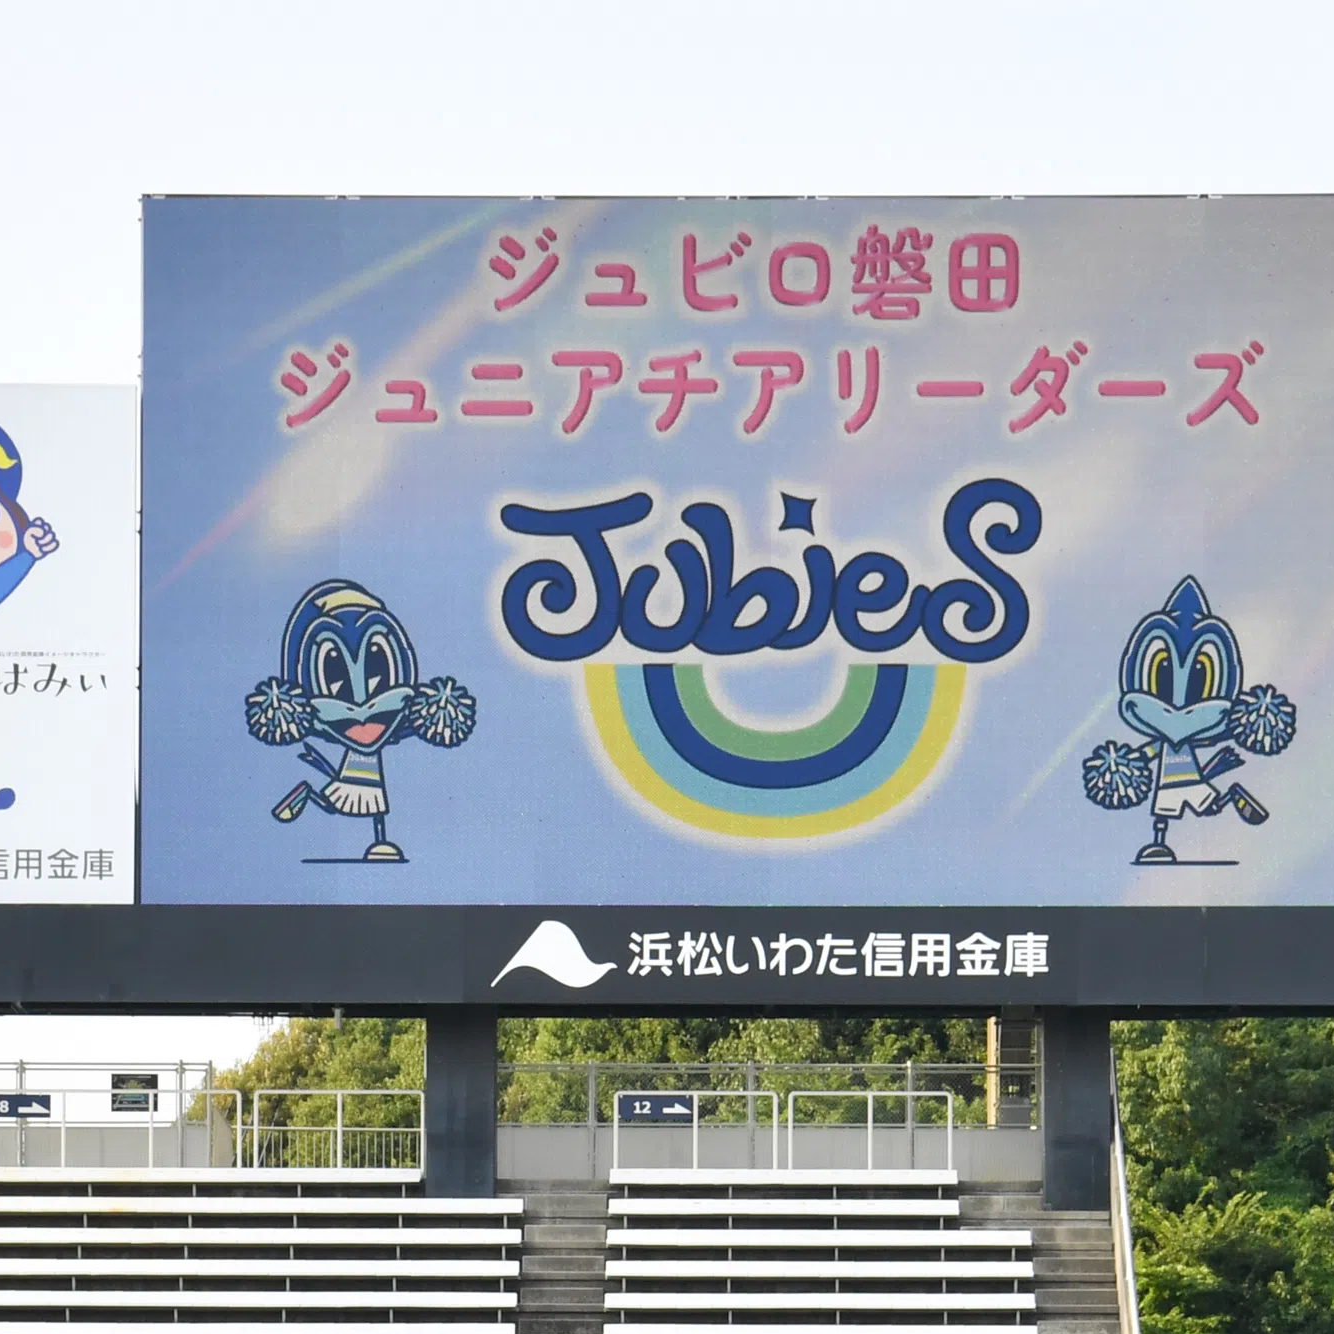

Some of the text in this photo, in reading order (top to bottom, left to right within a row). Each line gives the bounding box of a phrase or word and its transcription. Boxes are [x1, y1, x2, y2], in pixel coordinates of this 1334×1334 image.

[487, 224, 1021, 320] ジュビロ磐田
[277, 337, 1267, 436] ジュニアチアリーダーズ
[627, 929, 1049, 980] 浜松いわた信用金庫
[633, 1099, 651, 1115] 12
